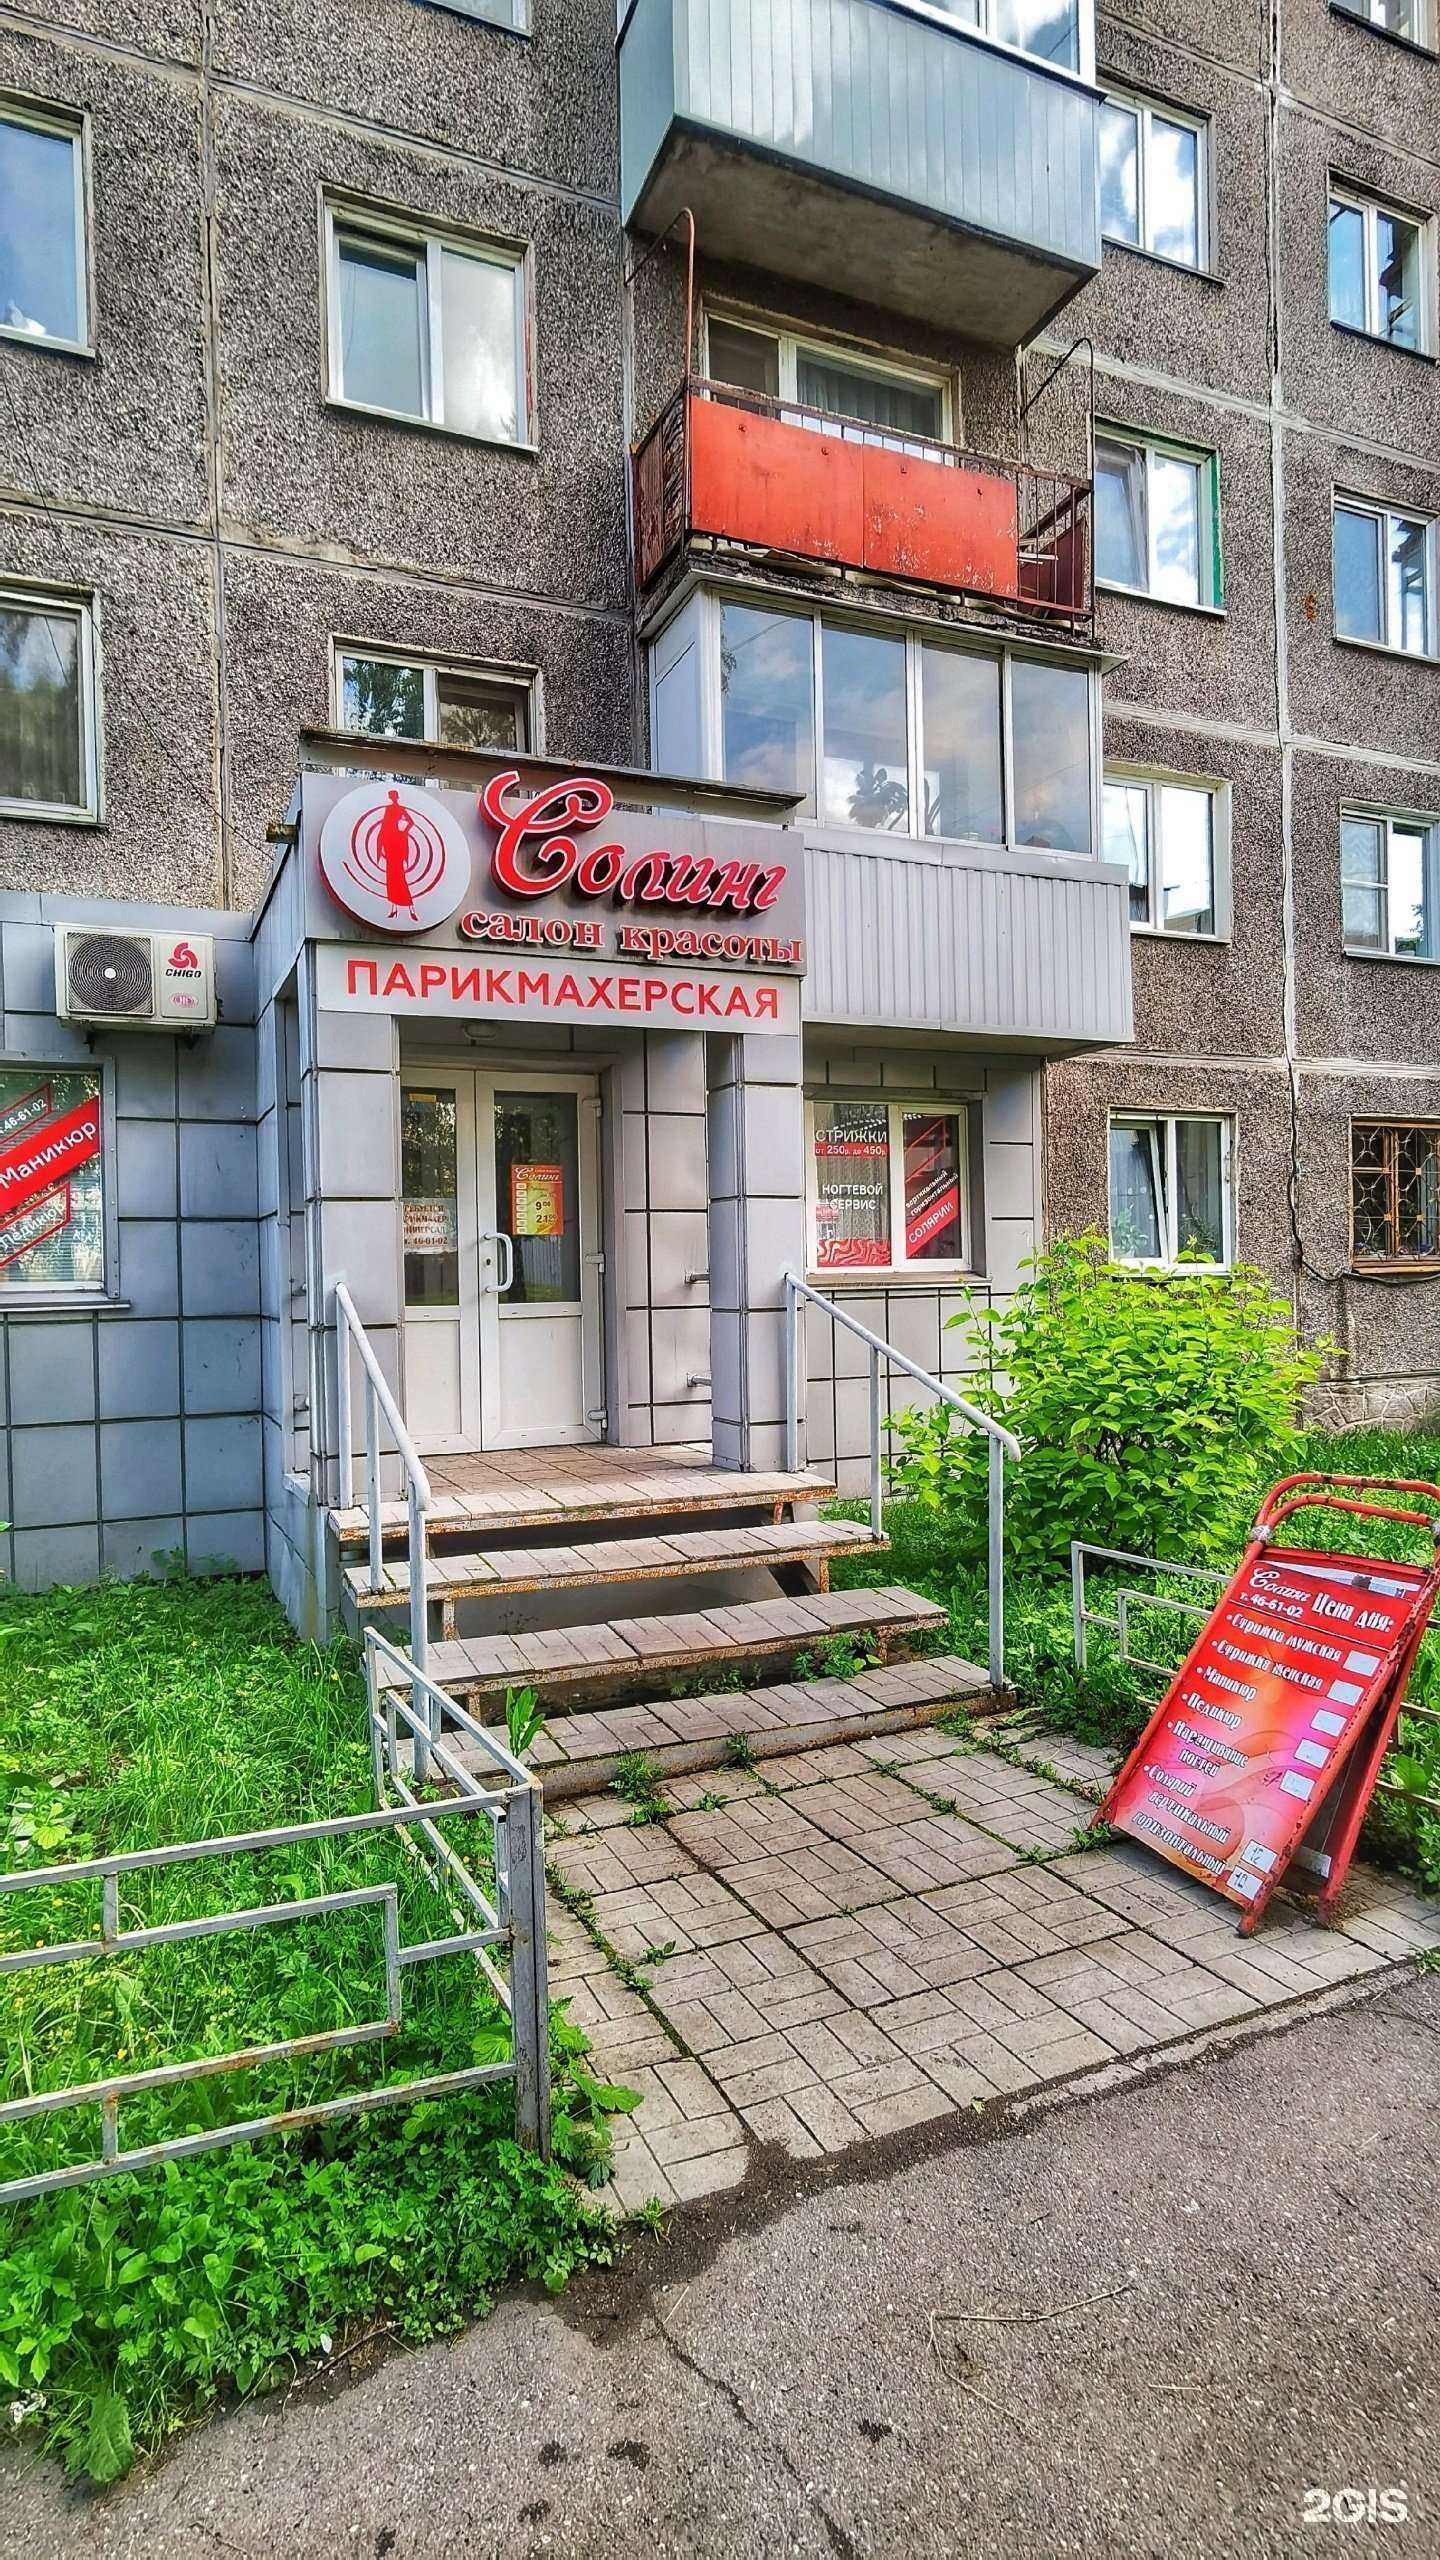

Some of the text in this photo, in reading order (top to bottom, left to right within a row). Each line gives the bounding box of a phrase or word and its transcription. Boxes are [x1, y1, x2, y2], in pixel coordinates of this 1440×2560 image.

[479, 770, 789, 911] Солинг
[461, 908, 803, 963] салон красоты
[165, 968, 202, 978] CHIGO
[347, 959, 778, 1018] ПАРИКМАХЕРСКАЯ
[0, 1121, 96, 1189] Маникюр
[815, 1129, 887, 1143] СТРИЖКИ
[822, 1183, 883, 1195] НОГТЕВОЙ
[829, 1199, 876, 1210] СЕРВИС
[905, 1170, 948, 1208] вертикальный
[910, 1173, 959, 1216] горизонтальный
[1250, 1568, 1312, 1602] Солинг
[1250, 1595, 1304, 1618] 46-61-02
[1312, 1592, 1394, 1632] Цена дня:
[1231, 1613, 1342, 1662] Стрижка мужская
[1203, 1665, 1257, 1702] Маникюр
[1217, 1641, 1324, 1691] Стрижка женская
[1187, 1692, 1242, 1730] Педикюр
[1173, 1720, 1249, 1769] Наращивание
[1179, 1749, 1221, 1777] ногтей
[1148, 1764, 1197, 1798] Солярий
[1148, 1791, 1231, 1845] вертикальный
[1132, 1812, 1227, 1876] горизонтальный
